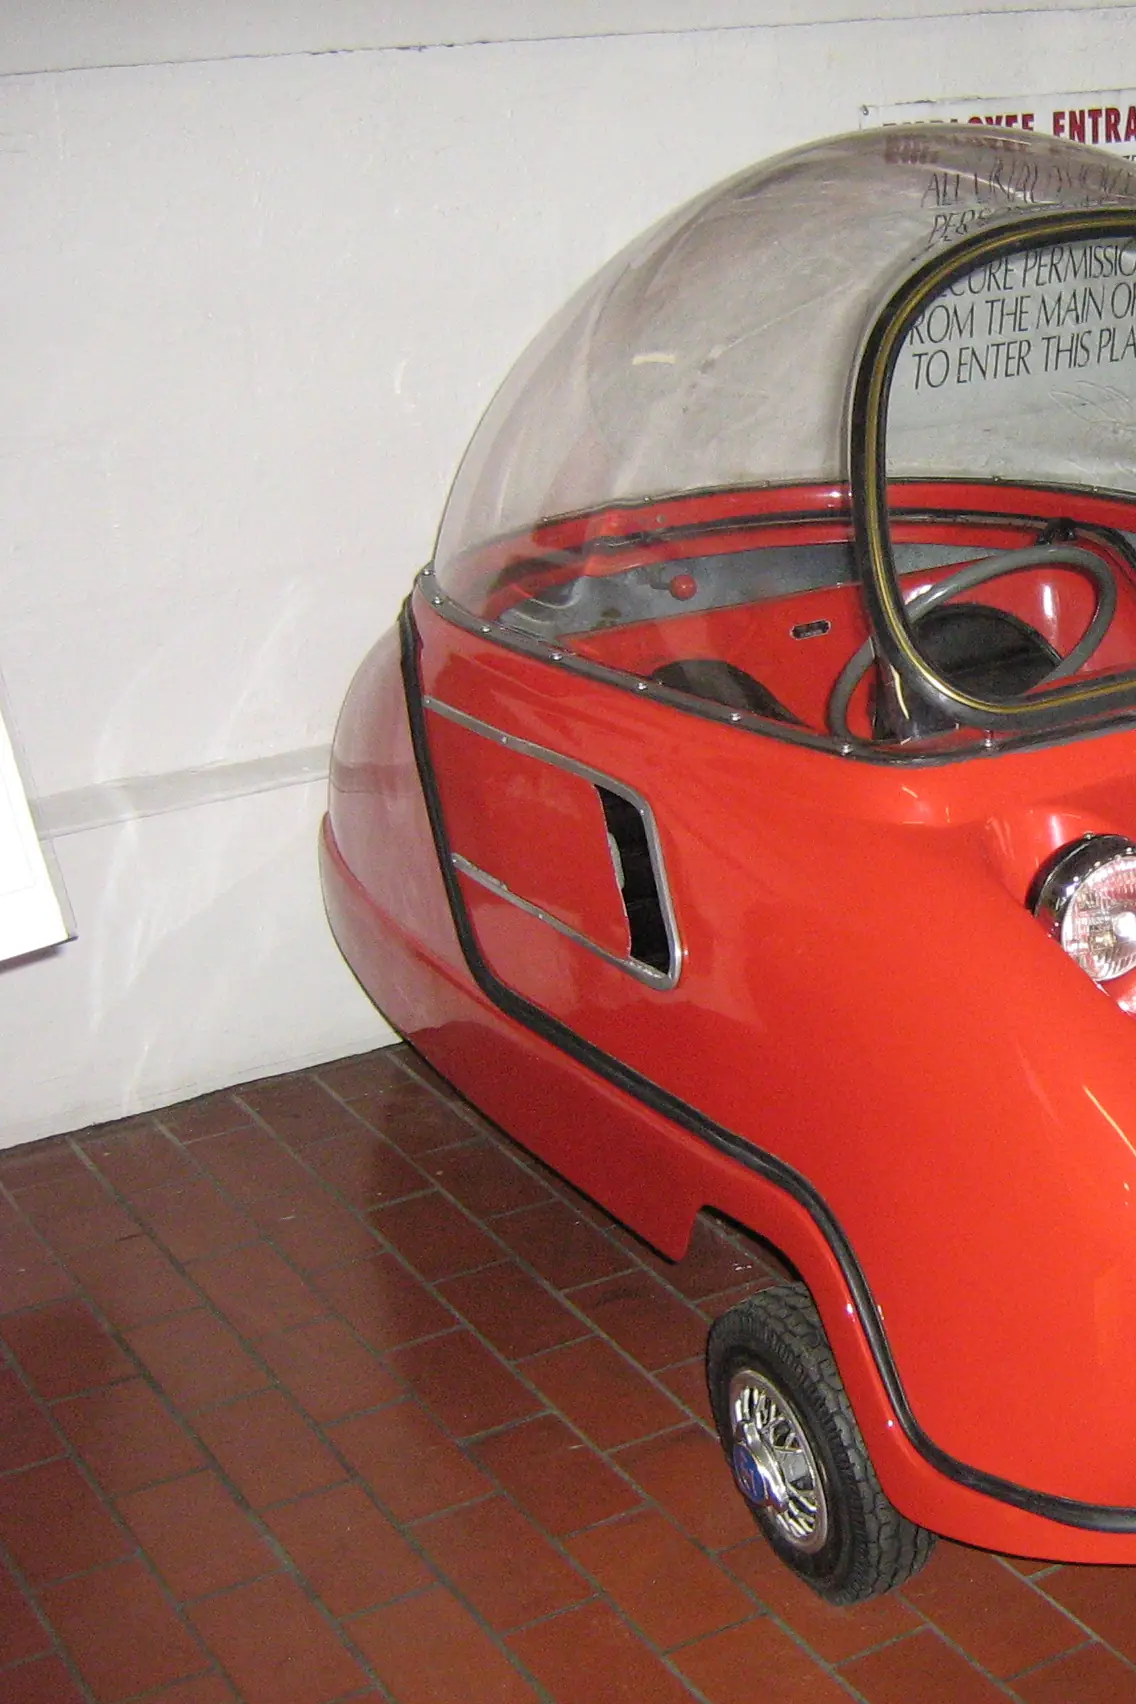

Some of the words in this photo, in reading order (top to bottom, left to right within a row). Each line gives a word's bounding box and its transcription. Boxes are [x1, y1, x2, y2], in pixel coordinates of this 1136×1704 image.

[909, 302, 976, 346] ROM
[985, 295, 1032, 336] THE
[1036, 283, 1106, 330] MAIN
[912, 349, 951, 390] TO
[956, 339, 1032, 384] ENTER
[1041, 330, 1093, 372] THIS
